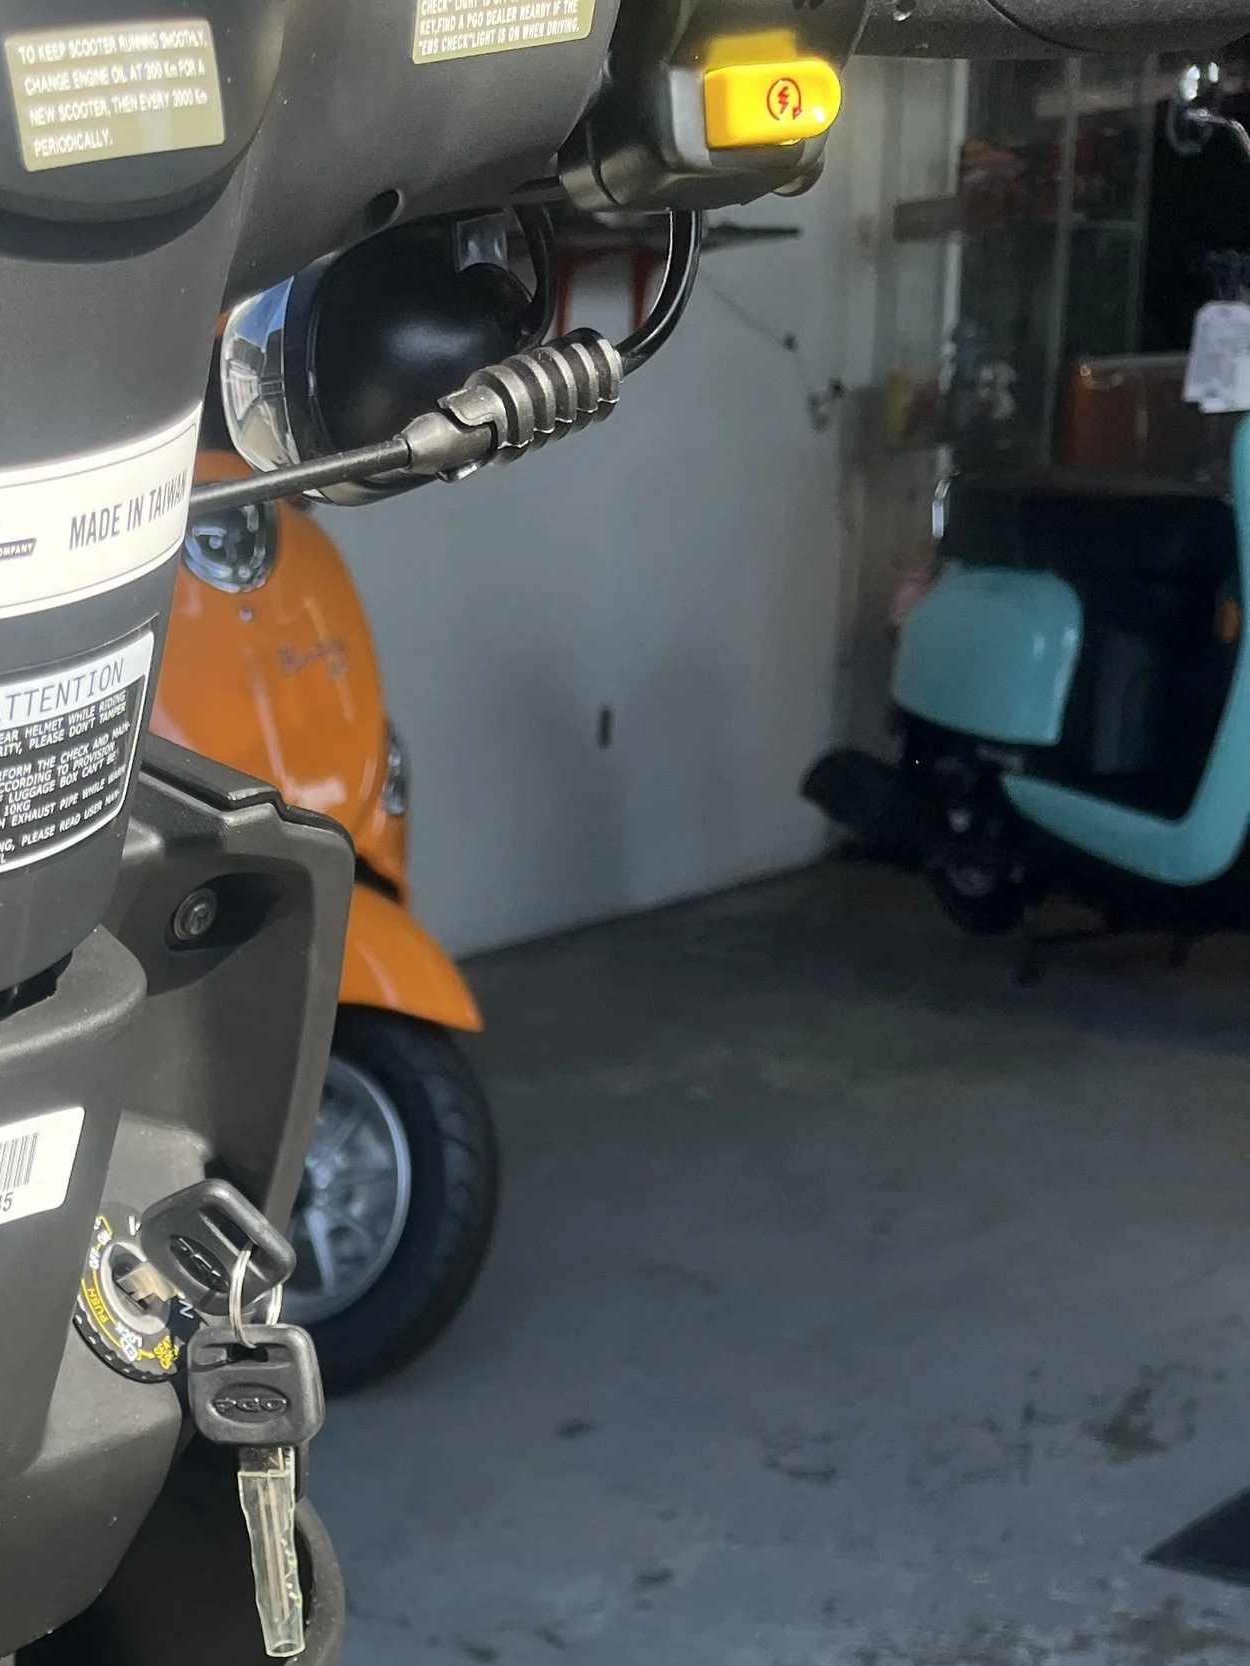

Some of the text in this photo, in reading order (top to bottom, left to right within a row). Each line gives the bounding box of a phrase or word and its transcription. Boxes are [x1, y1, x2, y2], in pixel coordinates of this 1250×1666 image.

[458, 14, 464, 30] A
[467, 11, 483, 28] PGO
[486, 7, 517, 26] DEALER
[520, 2, 551, 21] NEARBY
[553, 1, 561, 16] IF
[564, 0, 578, 14] THE
[498, 28, 506, 44] IS
[508, 25, 520, 41] ON
[522, 22, 544, 40] WHEN
[547, 17, 580, 36] DRIVING.
[18, 44, 36, 64] TO
[38, 41, 66, 62] KEEP
[69, 36, 117, 58] SCOOTER
[118, 32, 159, 52] RUNNING
[24, 71, 71, 96] CHANGE
[73, 67, 109, 89] ENGINE
[111, 64, 128, 84] OIL
[130, 63, 143, 81] AT
[145, 61, 163, 80] 300
[178, 58, 197, 77] FOR
[198, 58, 206, 75] A
[30, 105, 56, 126] NEW
[58, 98, 111, 122] SCOOTER,
[111, 94, 138, 114] THEN
[139, 91, 170, 111] EVERY
[172, 88, 193, 108] 3000
[34, 128, 113, 157] PERIODICALLY.
[69, 467, 188, 551] MADE IN TAIWAN
[25, 717, 64, 738] HELMET
[68, 705, 96, 725] WHILE
[99, 689, 126, 712] RIDING
[29, 729, 65, 750] PLEASE
[69, 717, 96, 738] DON'T
[99, 702, 126, 724] TAMPER
[38, 756, 56, 771] THE
[60, 743, 90, 764] CHECK
[92, 734, 109, 750] AND
[57, 763, 69, 777] TO
[73, 741, 116, 771] PROVISION
[8, 780, 56, 804] LUGGAGE
[59, 771, 79, 788] BOX
[82, 758, 104, 778] CAN'T
[106, 751, 117, 765] BE
[4, 800, 31, 817] 10KG
[11, 802, 56, 826] EXHAUST
[59, 793, 79, 810] PIPE
[82, 778, 105, 800] WHILE
[22, 825, 55, 846] PLEASE
[59, 813, 81, 832] READ
[84, 800, 103, 820] USER
[87, 1288, 108, 1324] PUSH
[115, 1321, 142, 1348] LOCK
[153, 1335, 171, 1355] SEAT
